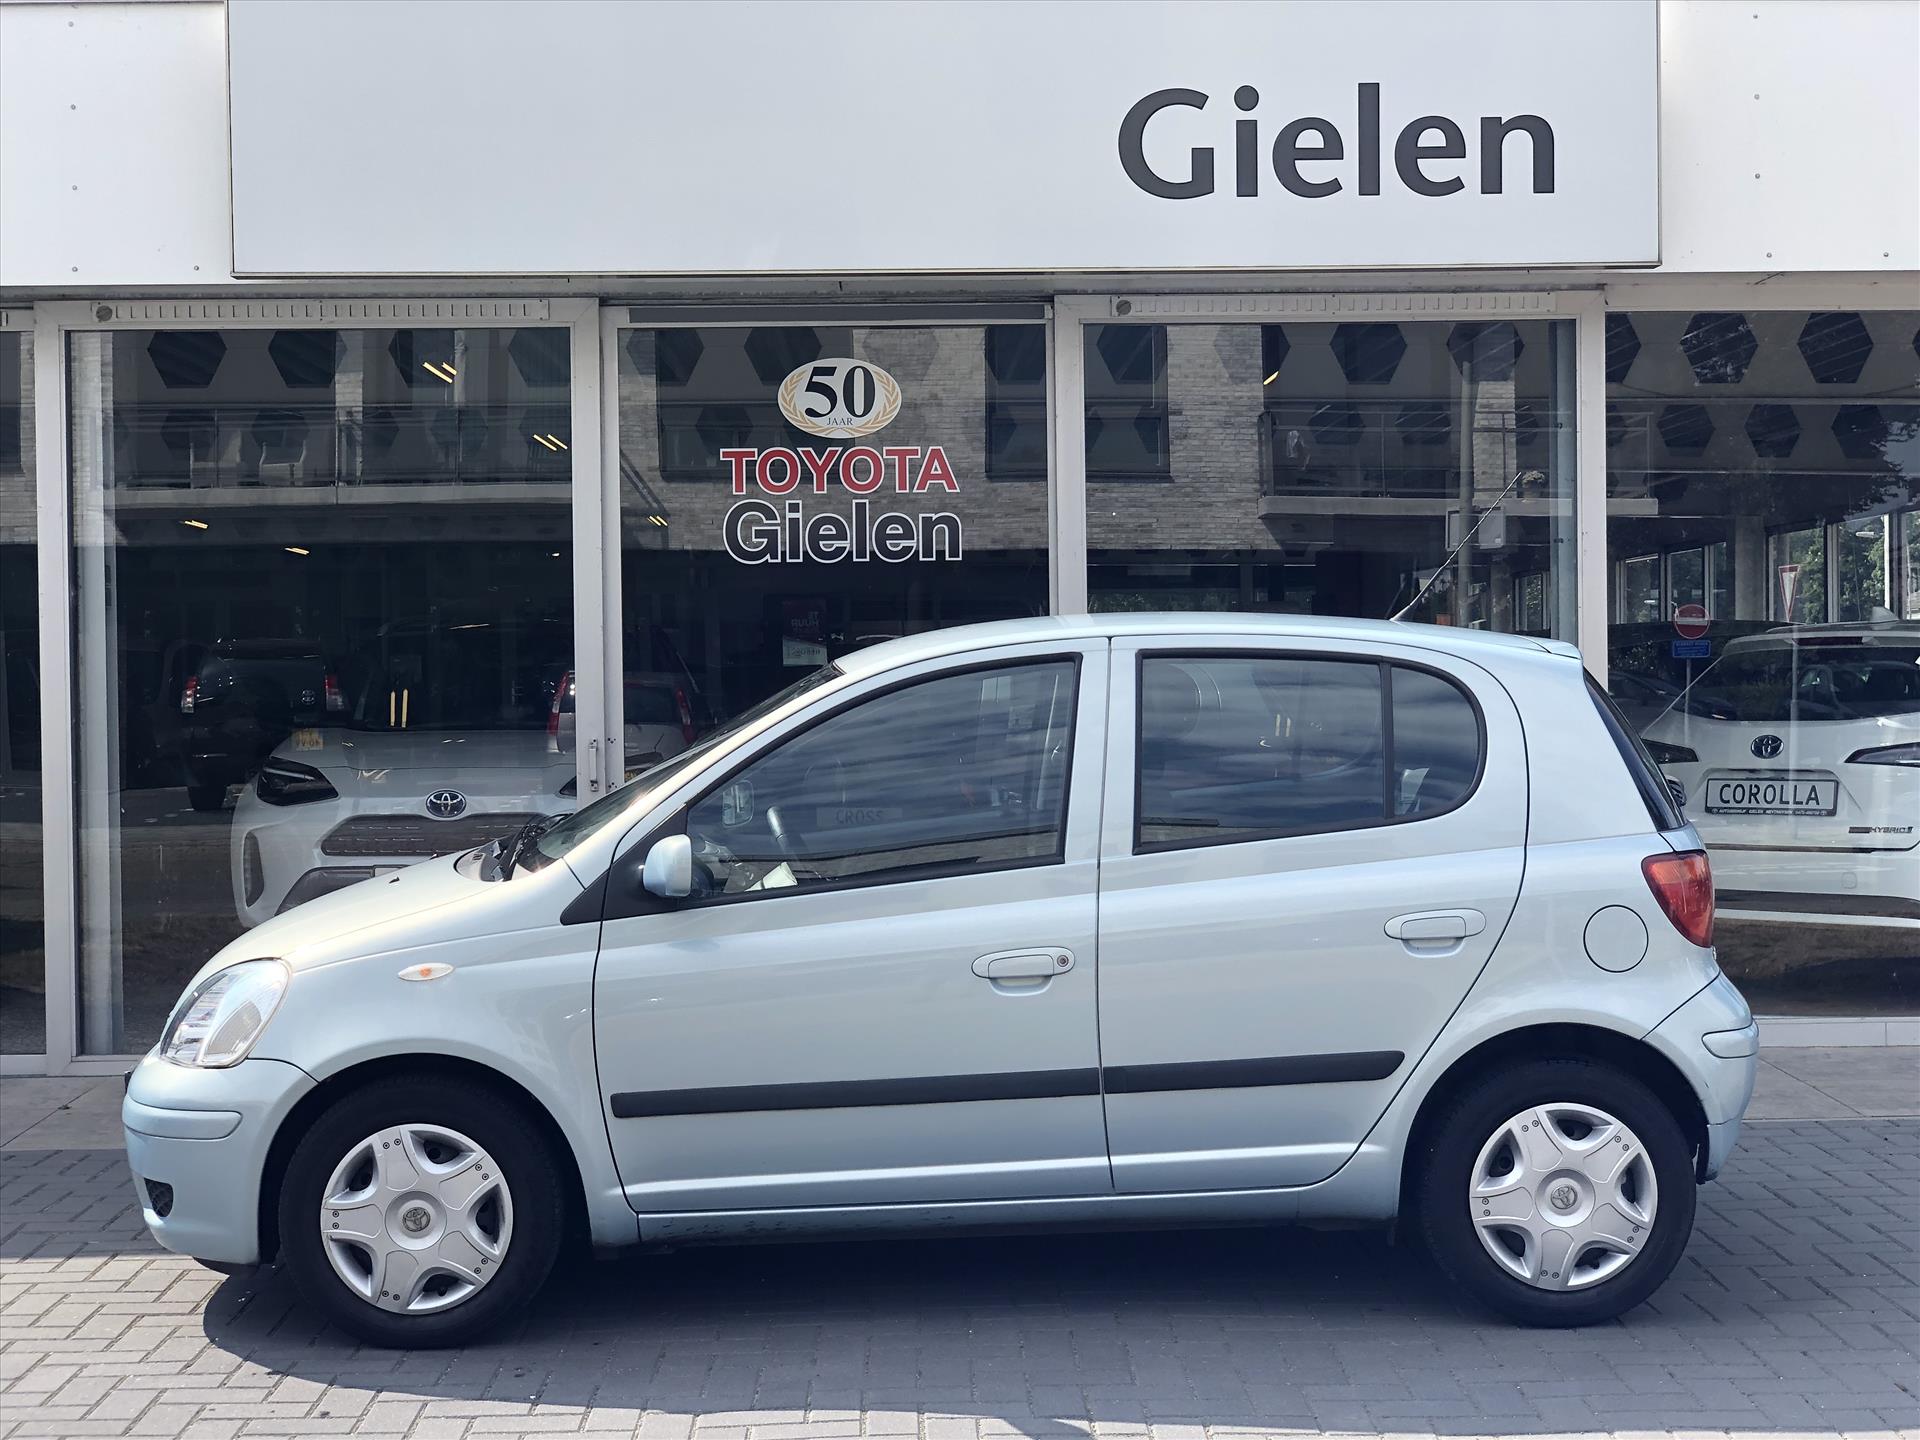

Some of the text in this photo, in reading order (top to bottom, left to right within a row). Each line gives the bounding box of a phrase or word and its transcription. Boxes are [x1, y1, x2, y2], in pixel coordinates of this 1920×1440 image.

[1118, 82, 1555, 200] Gielen
[804, 365, 876, 418] 50
[826, 417, 853, 426] JAAR
[720, 446, 960, 495] TOYOTA
[723, 499, 962, 564] Gielen
[1719, 783, 1820, 805] COROLLA
